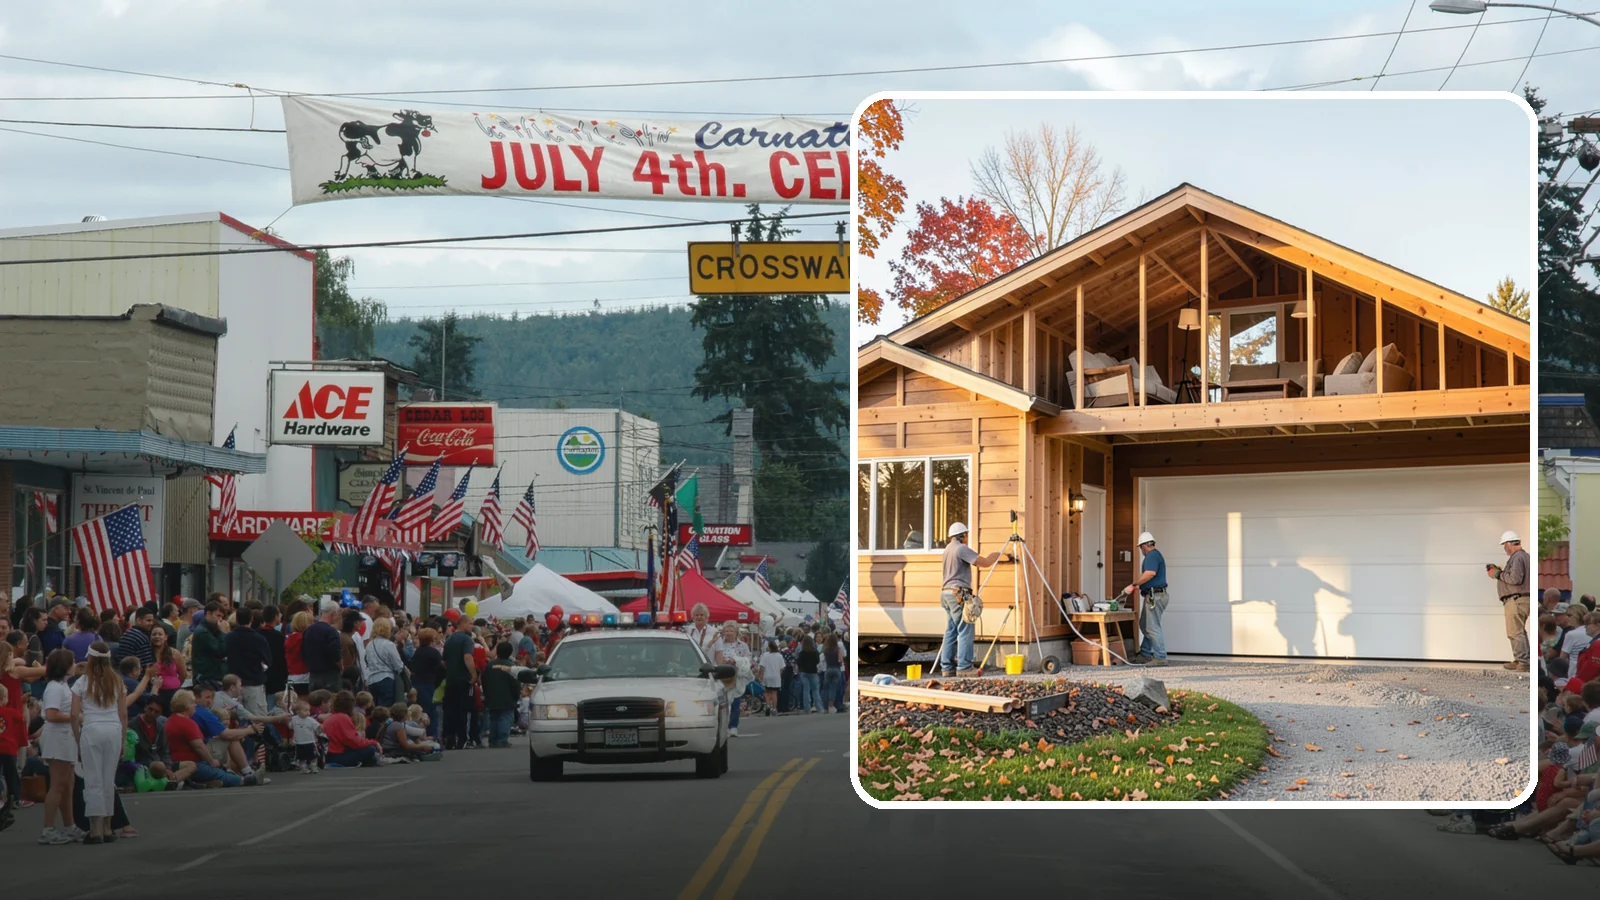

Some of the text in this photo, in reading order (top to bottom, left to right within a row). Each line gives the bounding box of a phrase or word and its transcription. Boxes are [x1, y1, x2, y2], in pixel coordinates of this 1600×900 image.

[481, 141, 604, 192] JULY
[632, 149, 746, 197] 4th.
[697, 254, 850, 280] CROSSWA
[283, 380, 373, 420] ACE
[406, 409, 485, 422] CEDAR LOG
[283, 421, 371, 436] Hardware
[416, 428, 476, 447] Coca-Cola
[353, 467, 386, 480] Simpl
[83, 485, 155, 495] St. Vincent de Paul
[213, 516, 331, 535] HARDARE
[688, 526, 741, 535] CRNATION
[699, 535, 730, 543] GLASS
